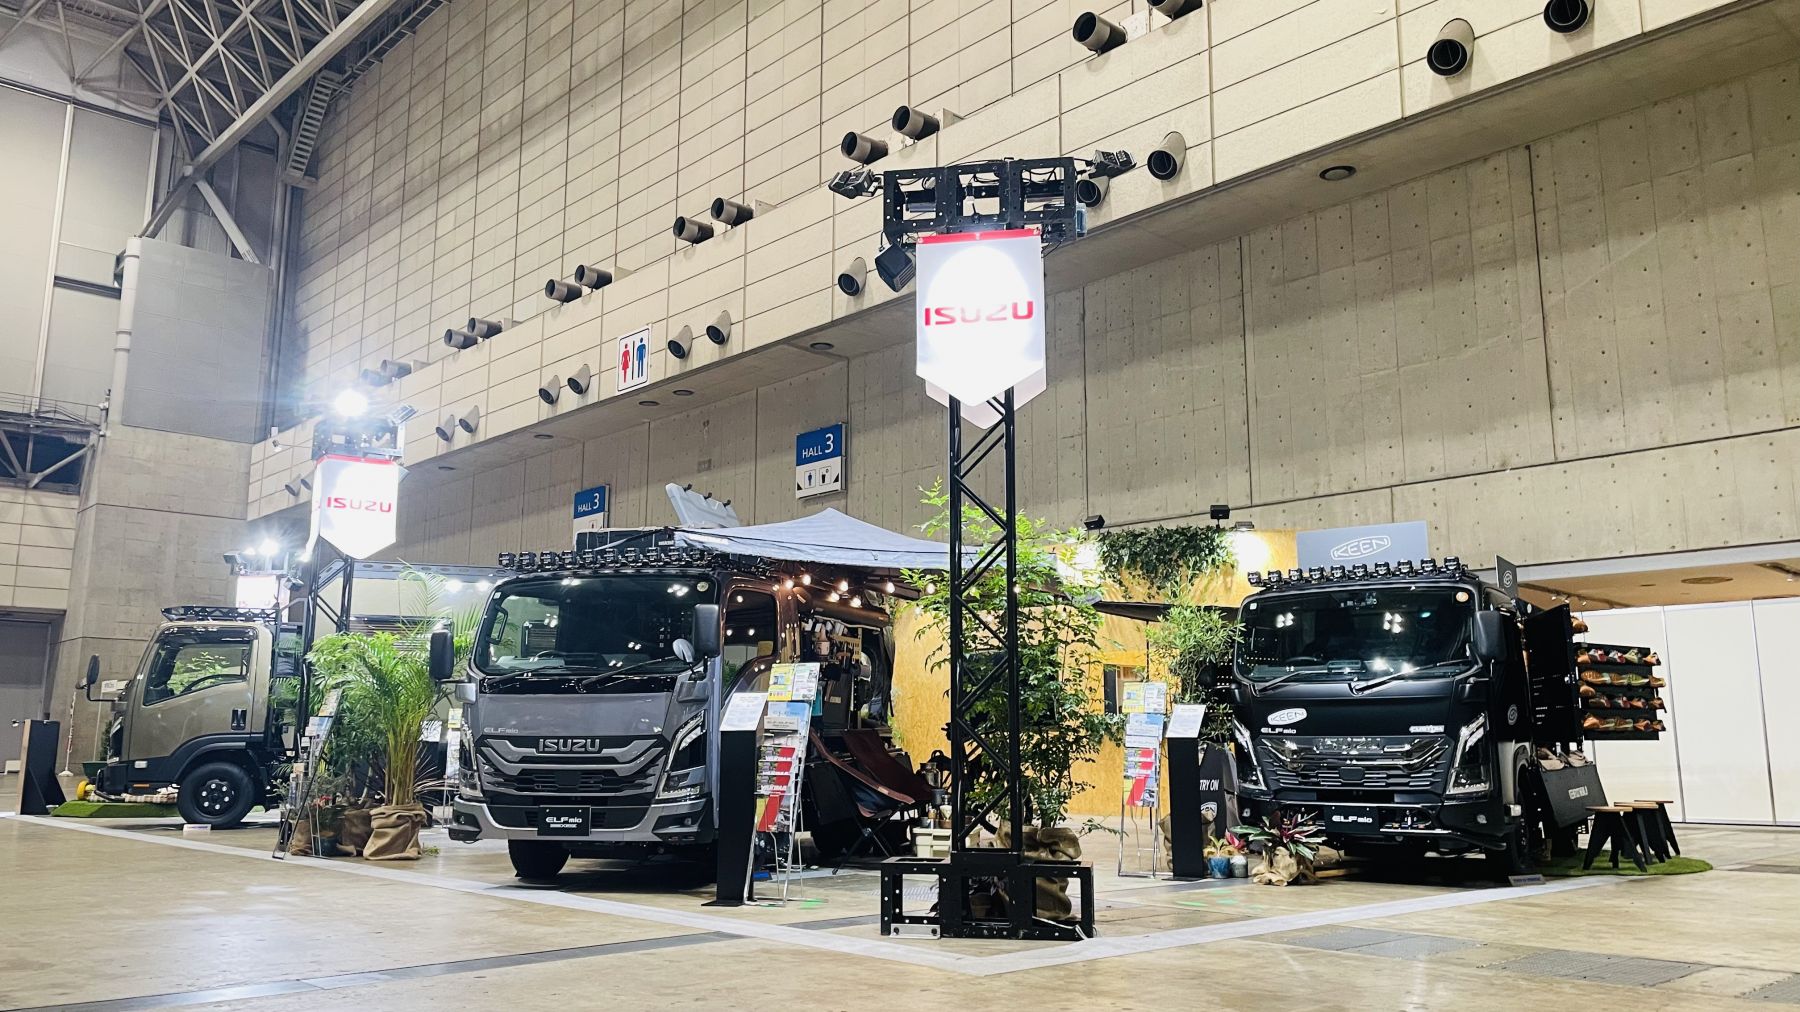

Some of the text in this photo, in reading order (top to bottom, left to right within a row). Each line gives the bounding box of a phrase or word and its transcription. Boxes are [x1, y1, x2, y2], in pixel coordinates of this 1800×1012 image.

[924, 300, 1034, 326] ISUZU
[802, 432, 834, 459] HALL 3
[326, 496, 392, 513] ISUZU
[577, 492, 600, 512] HALL 3
[1333, 537, 1388, 558] KEEN
[1270, 711, 1305, 722] KEEN
[538, 738, 600, 752] ISUZU
[1210, 779, 1219, 791] ON
